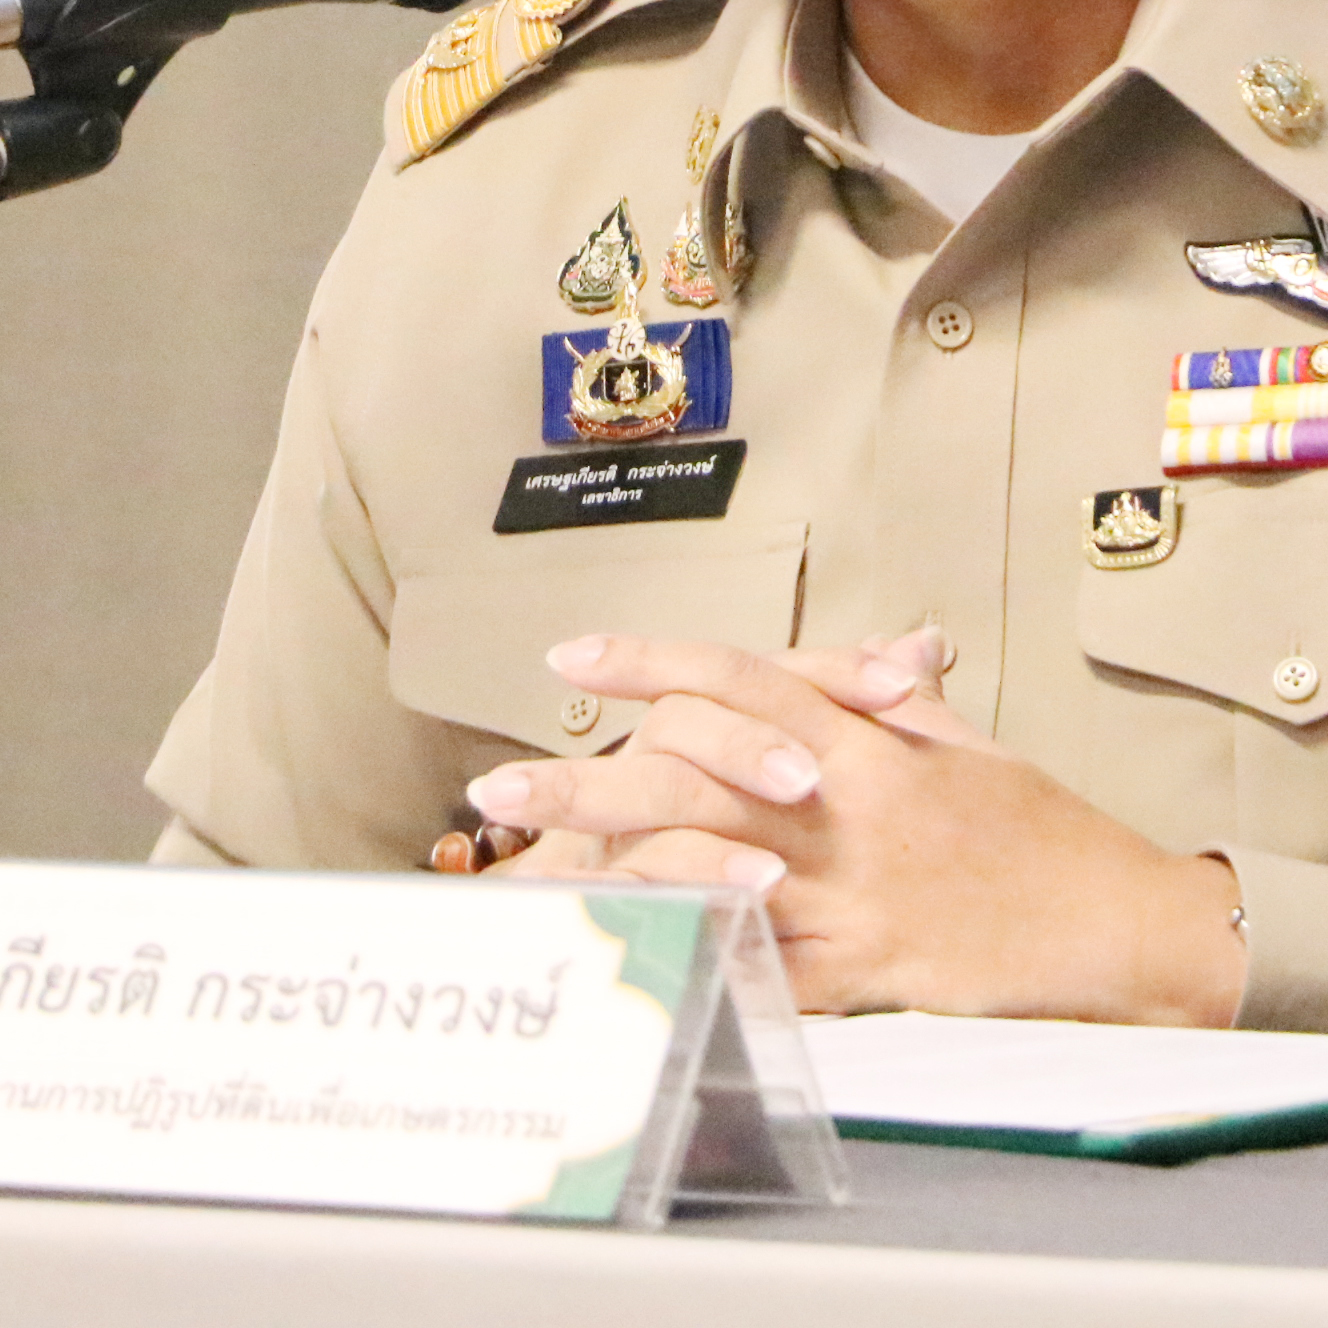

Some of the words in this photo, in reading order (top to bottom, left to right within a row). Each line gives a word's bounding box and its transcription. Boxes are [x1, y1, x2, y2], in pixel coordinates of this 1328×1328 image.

[186, 954, 571, 1039] กระจ่างวงษ์
